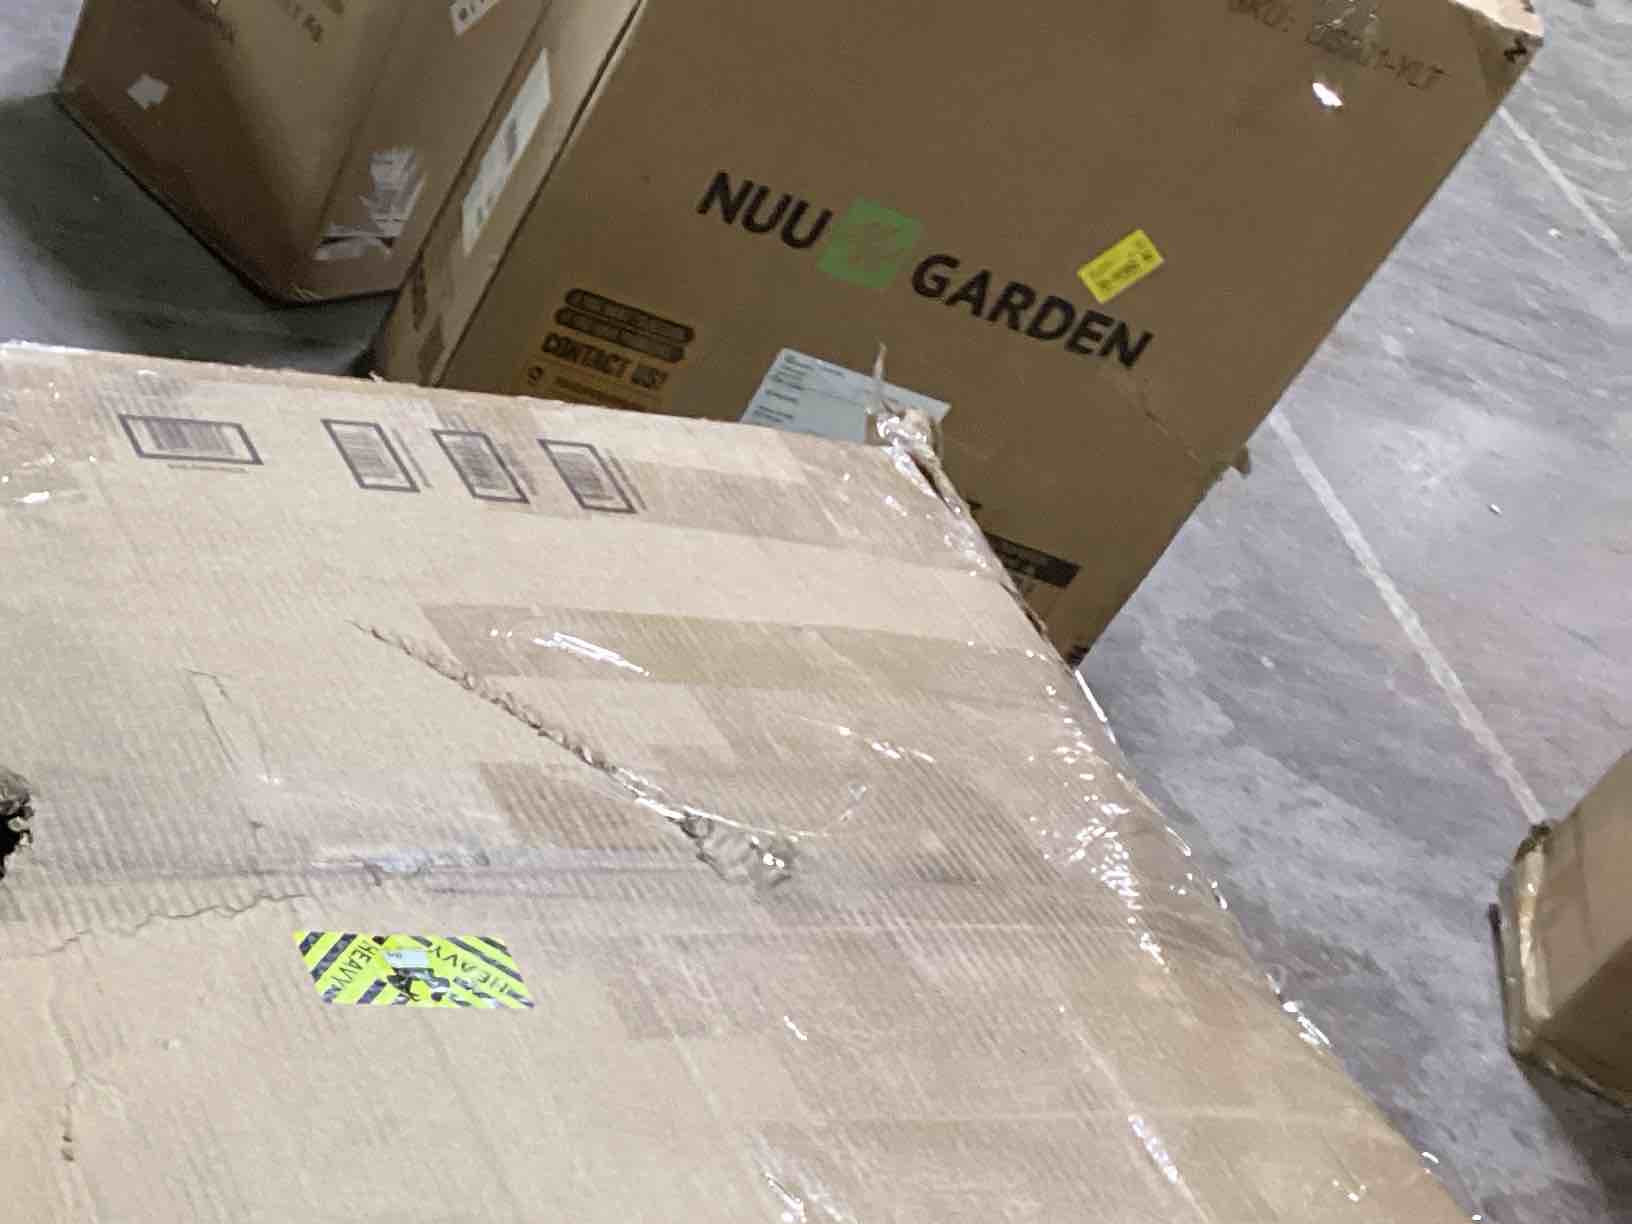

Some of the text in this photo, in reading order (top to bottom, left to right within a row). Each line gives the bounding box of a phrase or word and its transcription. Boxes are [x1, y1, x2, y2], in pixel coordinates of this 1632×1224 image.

[697, 169, 1154, 370] NUU GARDEN
[329, 942, 378, 991] HEAVY
[433, 945, 509, 993] HEAVY
